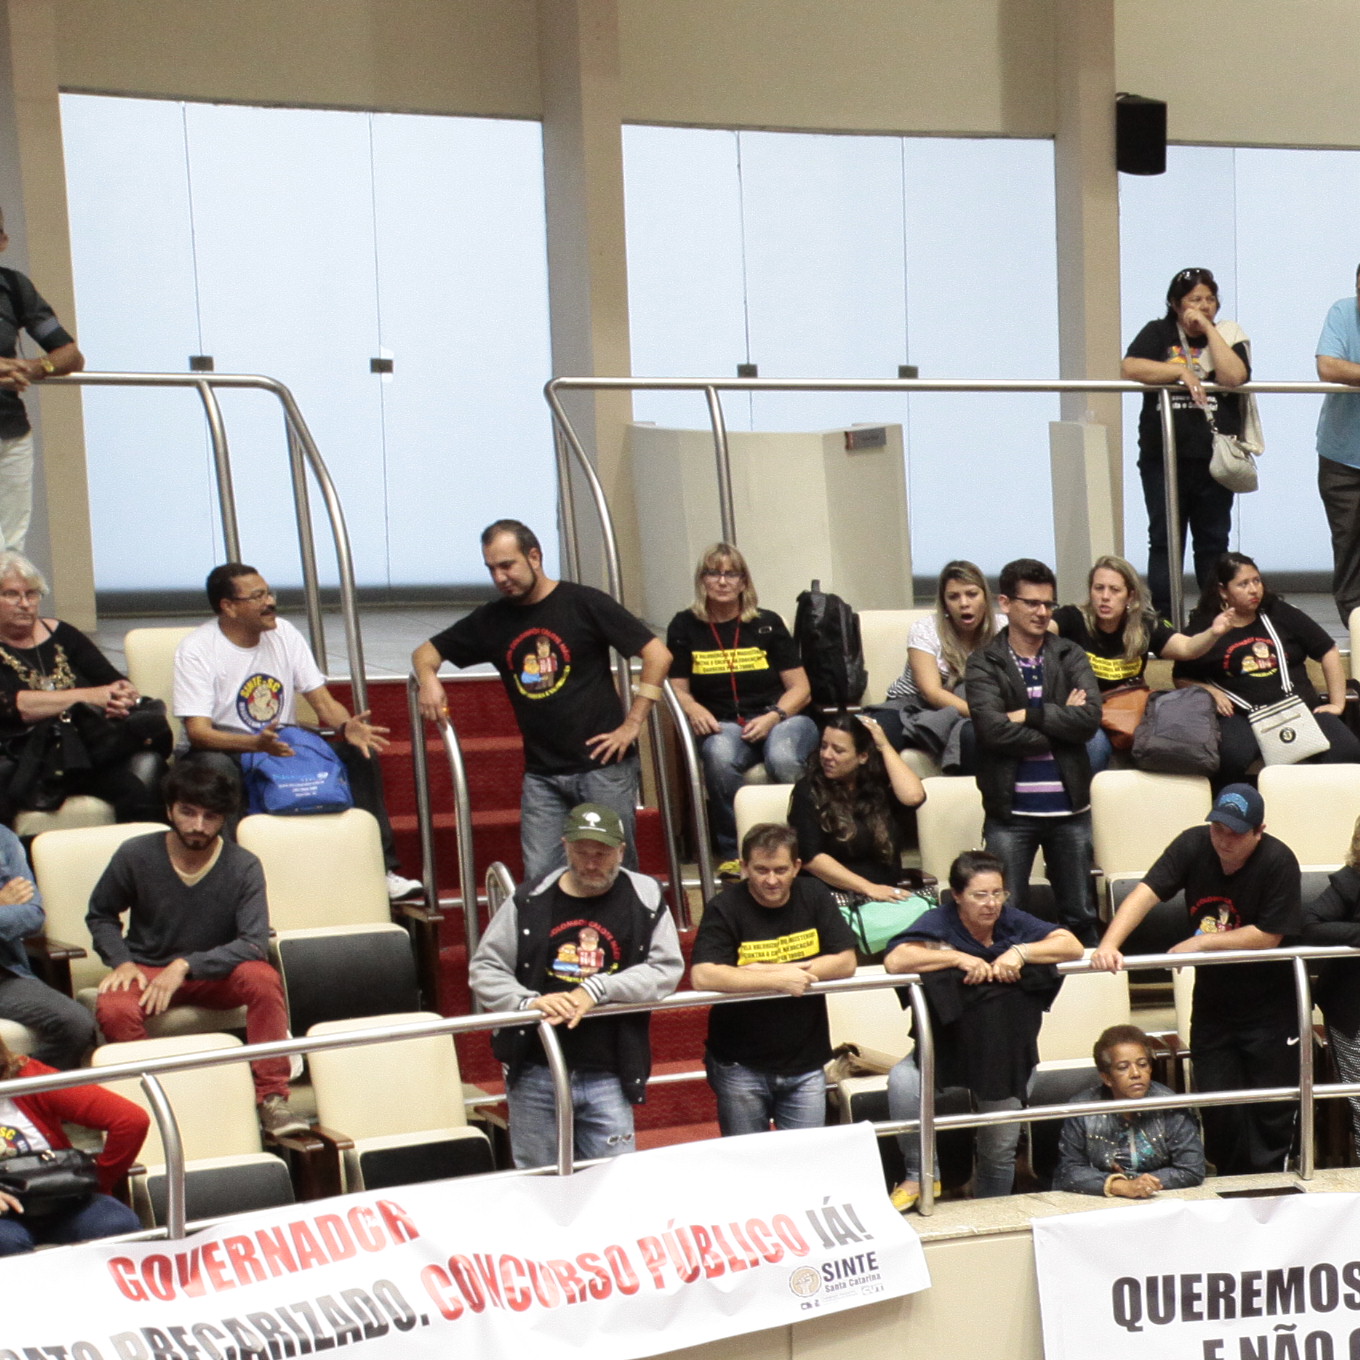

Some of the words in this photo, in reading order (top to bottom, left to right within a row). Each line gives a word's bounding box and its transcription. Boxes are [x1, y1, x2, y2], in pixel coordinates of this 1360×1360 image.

[106, 1199, 420, 1302] GOVERNADOR
[419, 1242, 640, 1321] CONCURSO
[636, 1213, 811, 1289] PÚBLICO
[805, 1195, 875, 1250] JÁ!
[821, 1251, 879, 1282] SINTE
[825, 1281, 847, 1293] Santa
[848, 1273, 881, 1287] Catarina
